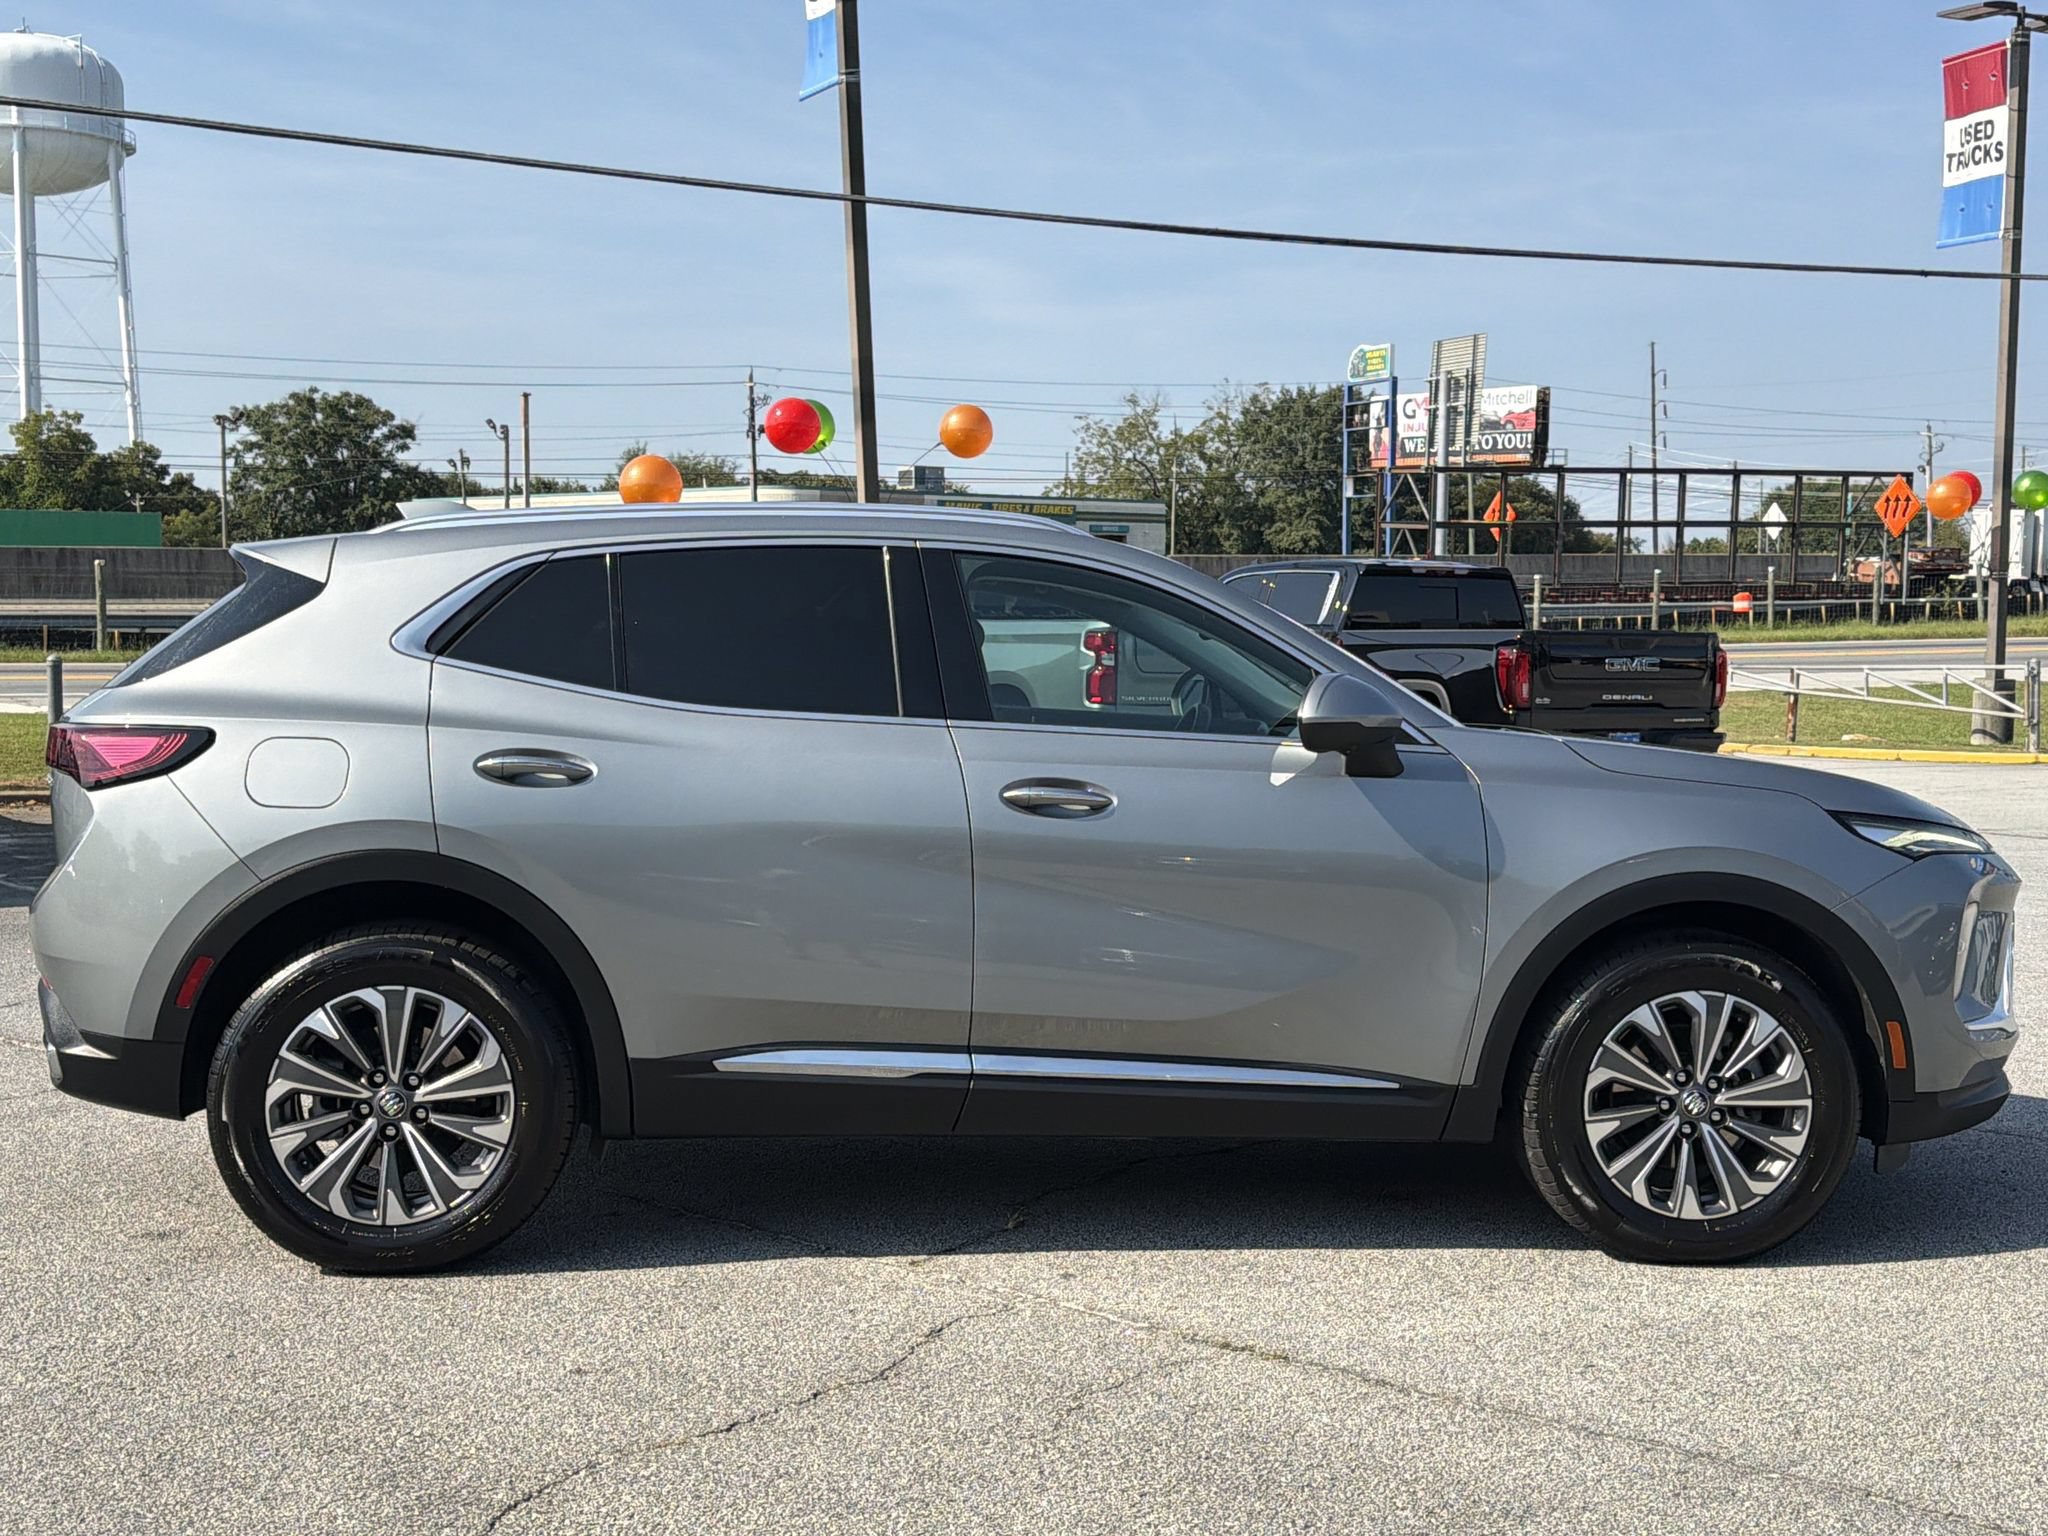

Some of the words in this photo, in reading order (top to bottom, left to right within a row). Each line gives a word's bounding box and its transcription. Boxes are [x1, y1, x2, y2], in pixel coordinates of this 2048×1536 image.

[1960, 119, 1995, 149] USED
[1946, 140, 2004, 174] TRUCKS
[1402, 422, 1429, 433] INJU
[1404, 438, 1426, 453] WE
[1493, 432, 1533, 450] YOU!
[1032, 504, 1074, 515] BRAKES
[1604, 657, 1661, 672] GMC
